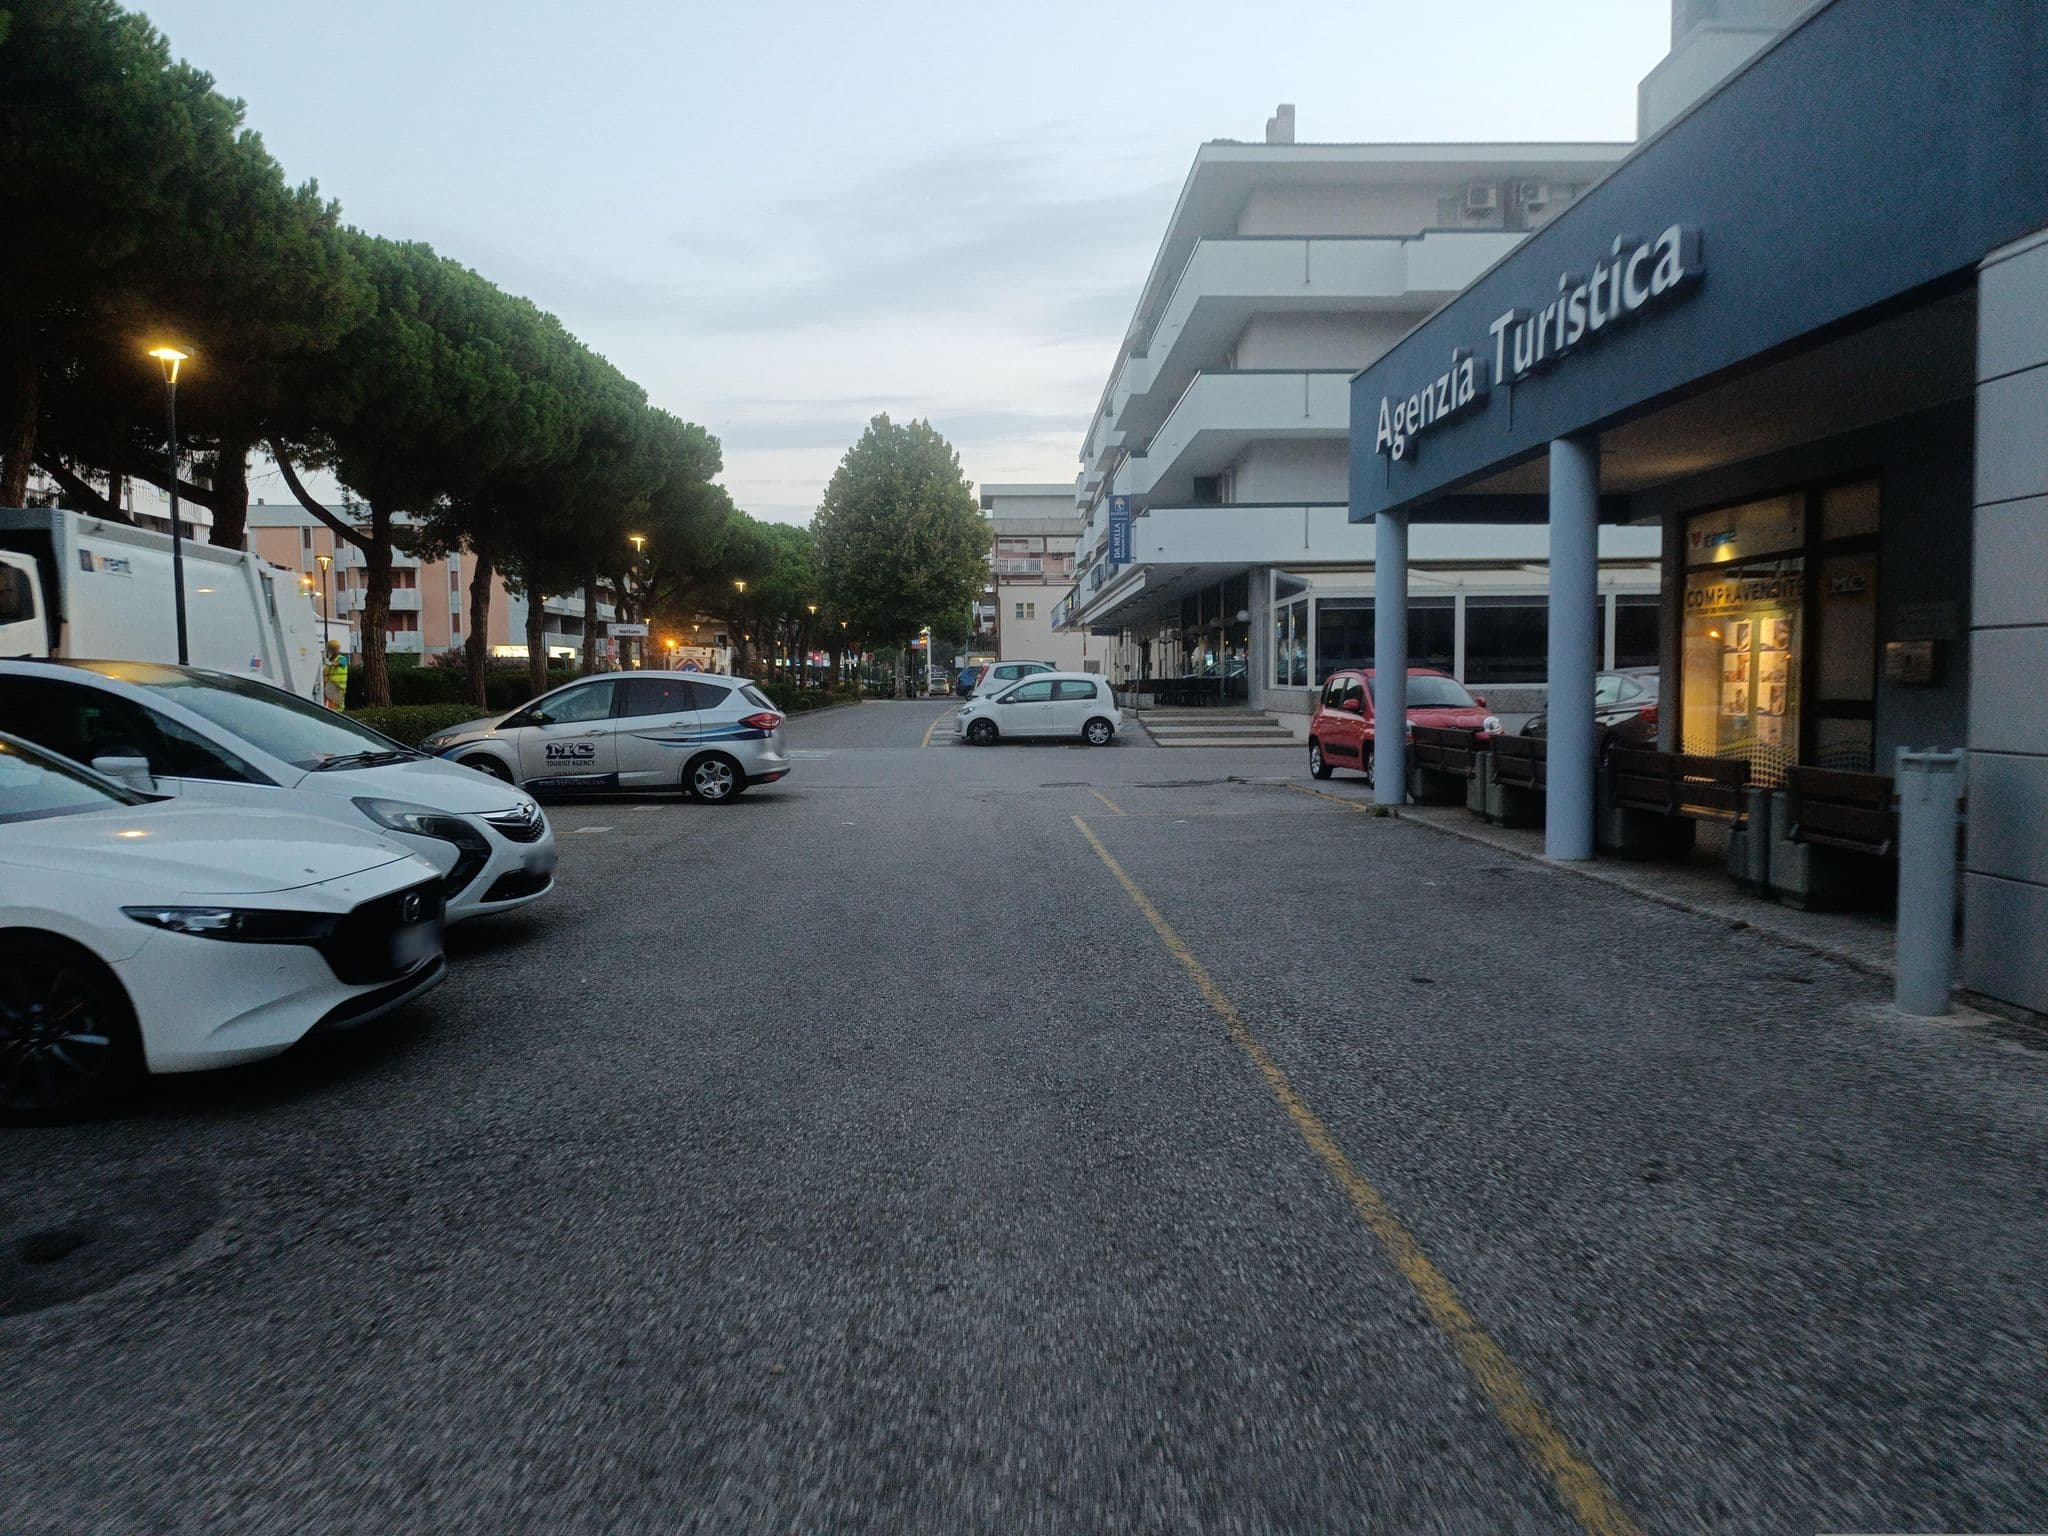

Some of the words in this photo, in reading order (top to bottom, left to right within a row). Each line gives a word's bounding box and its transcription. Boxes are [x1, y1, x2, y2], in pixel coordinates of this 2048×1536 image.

[1375, 346, 1476, 462] Agenzia
[1489, 223, 1686, 387] Turistica
[1114, 547, 1121, 559] DA
[546, 743, 595, 759] MC
